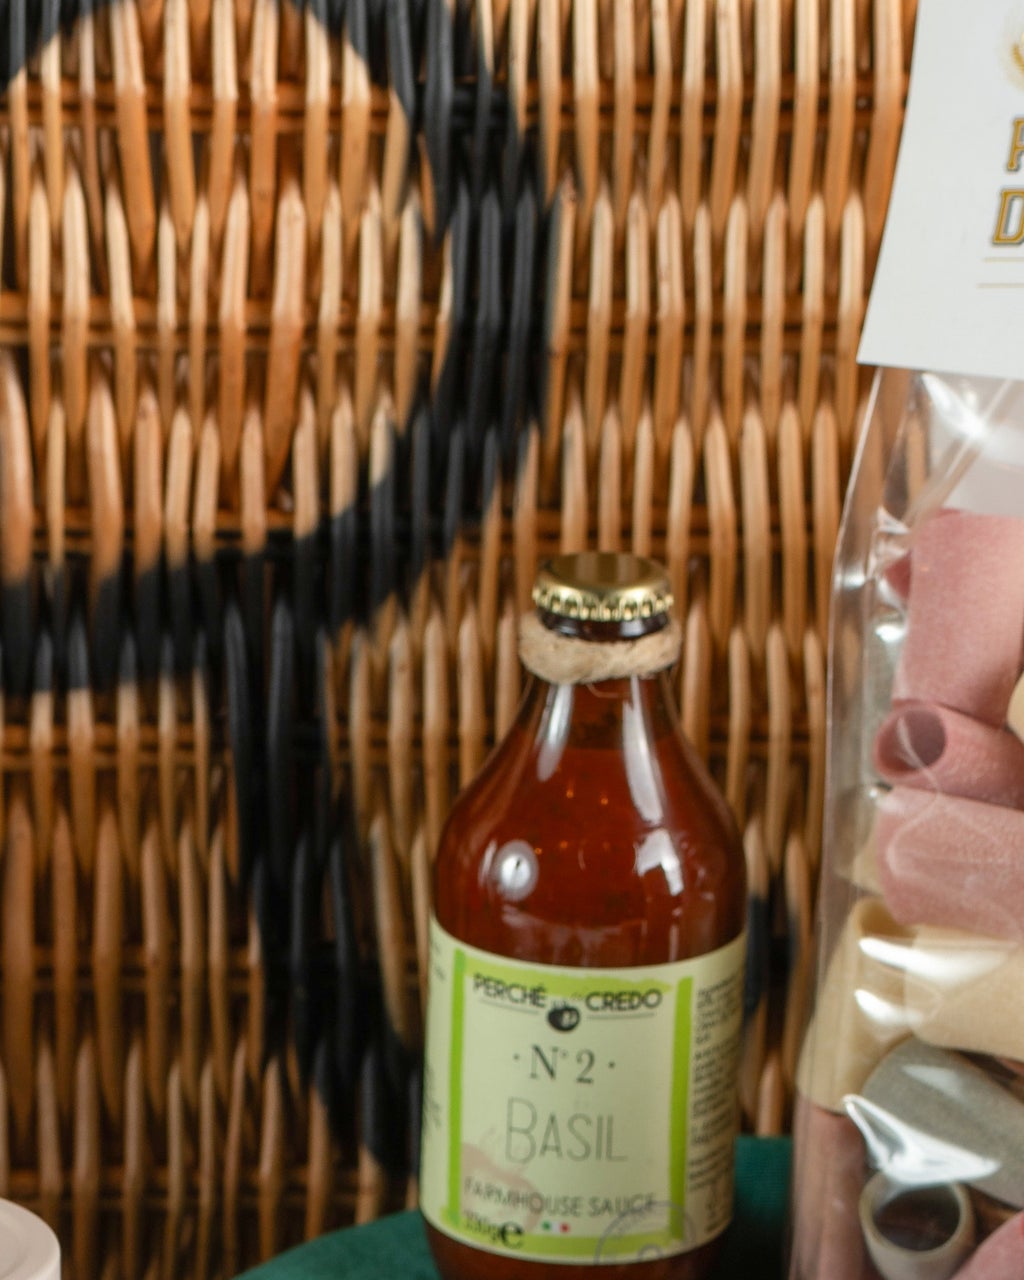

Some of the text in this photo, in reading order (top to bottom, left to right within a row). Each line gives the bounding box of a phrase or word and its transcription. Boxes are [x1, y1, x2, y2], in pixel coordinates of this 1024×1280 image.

[472, 972, 663, 1011] PERCHÉ CREDO
[575, 1049, 595, 1084] 2
